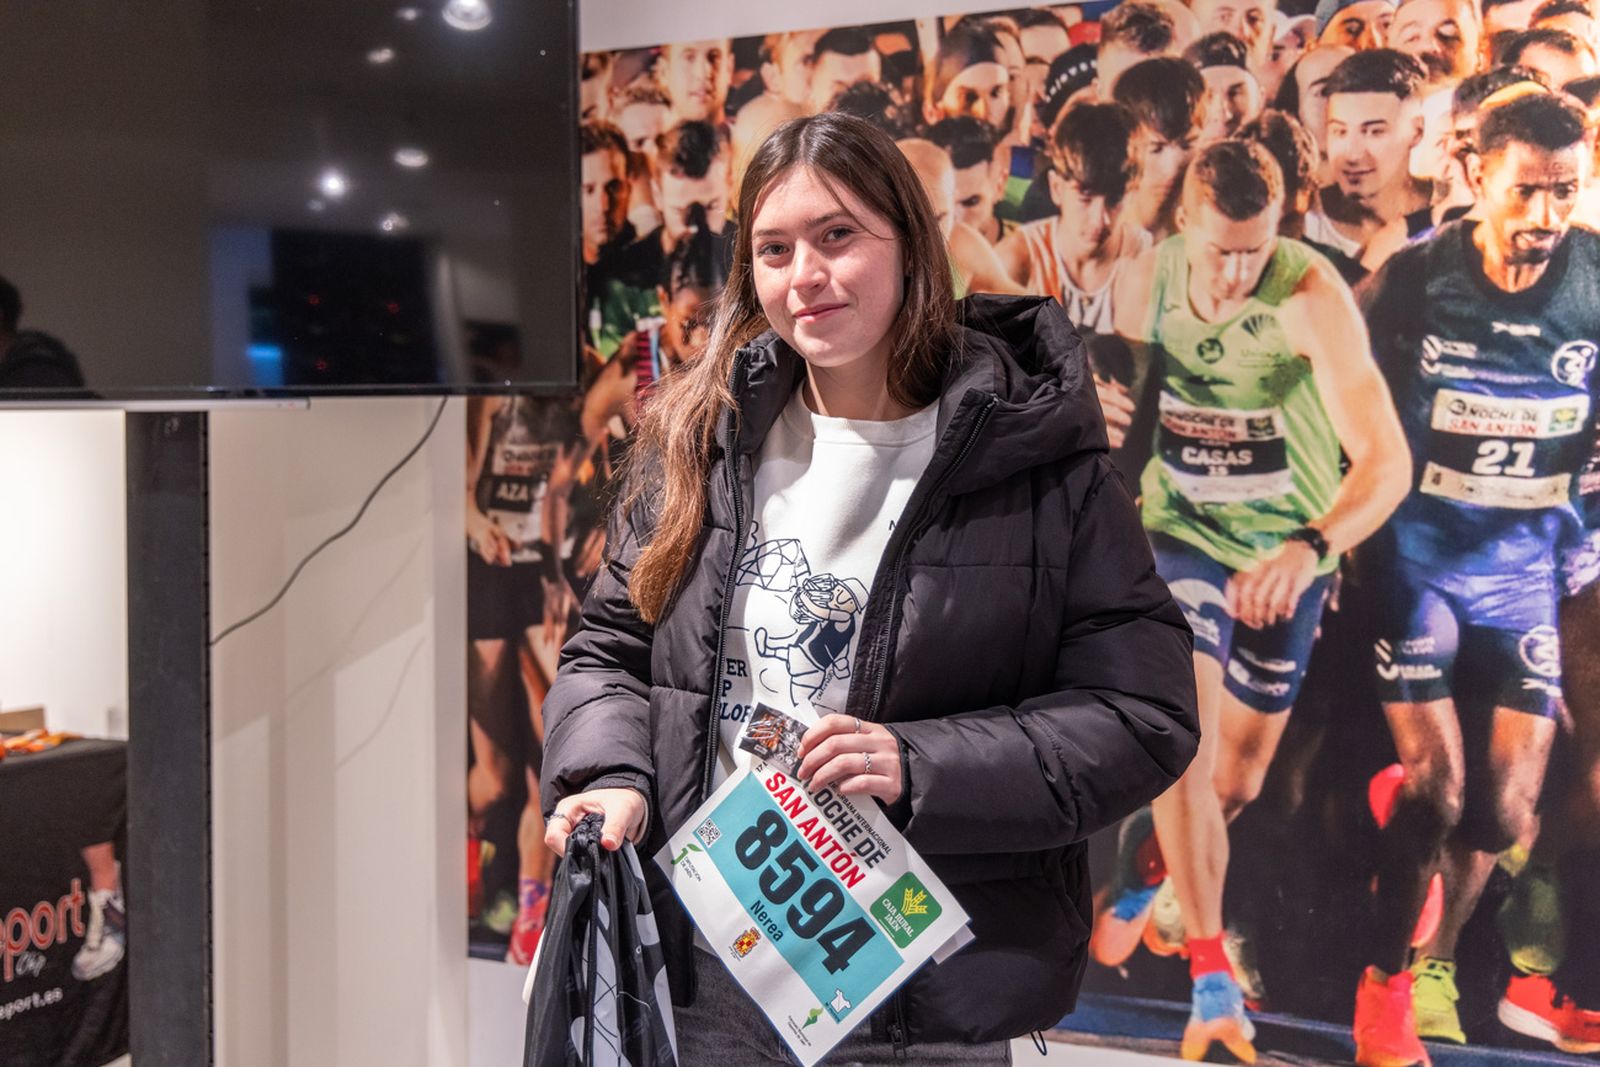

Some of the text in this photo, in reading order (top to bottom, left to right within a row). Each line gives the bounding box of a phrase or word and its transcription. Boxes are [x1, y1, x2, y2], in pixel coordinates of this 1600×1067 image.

[1181, 446, 1254, 466] CASAS
[1471, 439, 1536, 478] 21
[765, 771, 866, 889] SAN ANTÓN
[804, 781, 887, 869] OCHE DE
[854, 811, 892, 855] INTERNACIONAL
[734, 809, 877, 976] 8594
[751, 900, 784, 942] Nerea
[0, 877, 86, 982] port
